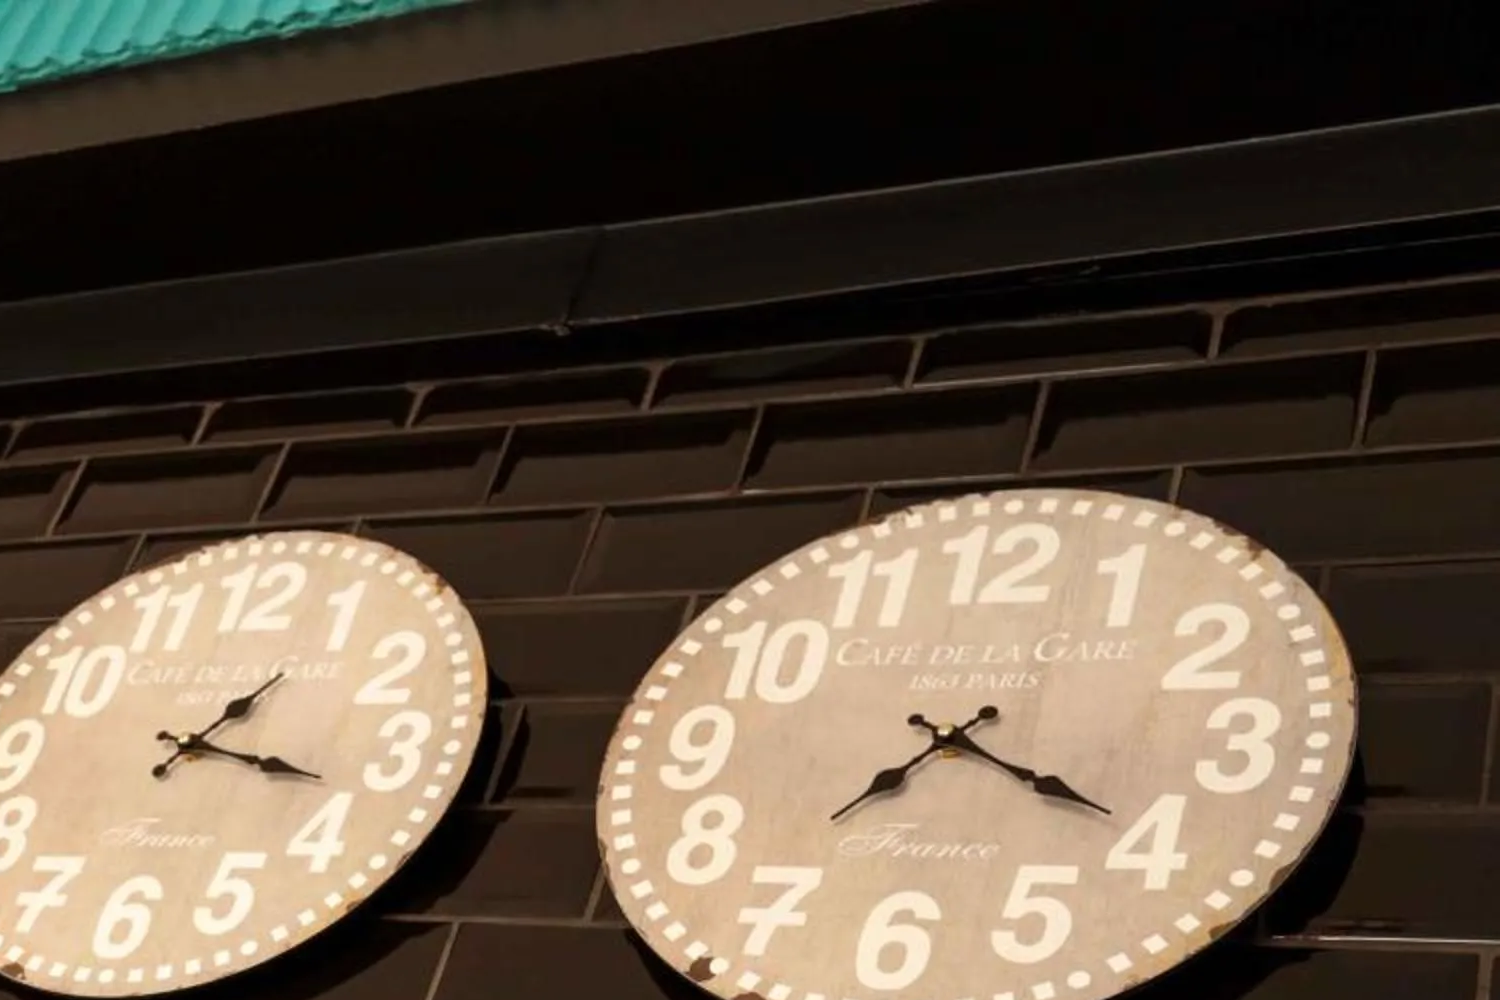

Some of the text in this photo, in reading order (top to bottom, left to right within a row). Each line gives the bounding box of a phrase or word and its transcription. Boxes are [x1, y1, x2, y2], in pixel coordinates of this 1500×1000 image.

[218, 563, 306, 632] 12
[829, 549, 918, 628] 11
[943, 524, 1059, 604] 12
[1098, 545, 1145, 627] 1
[130, 584, 202, 652] 11
[327, 581, 365, 650] 1
[929, 644, 975, 665] DE
[978, 643, 1021, 664] LA
[1033, 632, 1138, 662] GARE
[1162, 604, 1249, 689] 2
[43, 646, 126, 717] 10
[354, 631, 425, 704] 2
[723, 620, 829, 703] 10
[963, 671, 1042, 690] PARIS
[364, 711, 431, 790] 3
[660, 705, 734, 789] 9
[1196, 698, 1281, 793] 3
[287, 793, 352, 872] 4
[667, 795, 743, 885] 8
[838, 823, 1001, 858] France
[1106, 794, 1187, 889] 4
[17, 857, 84, 933] 7
[93, 876, 162, 958] 6
[194, 853, 267, 934] 5
[739, 867, 823, 955] 7
[992, 865, 1078, 963] 5
[856, 892, 940, 990] 6
